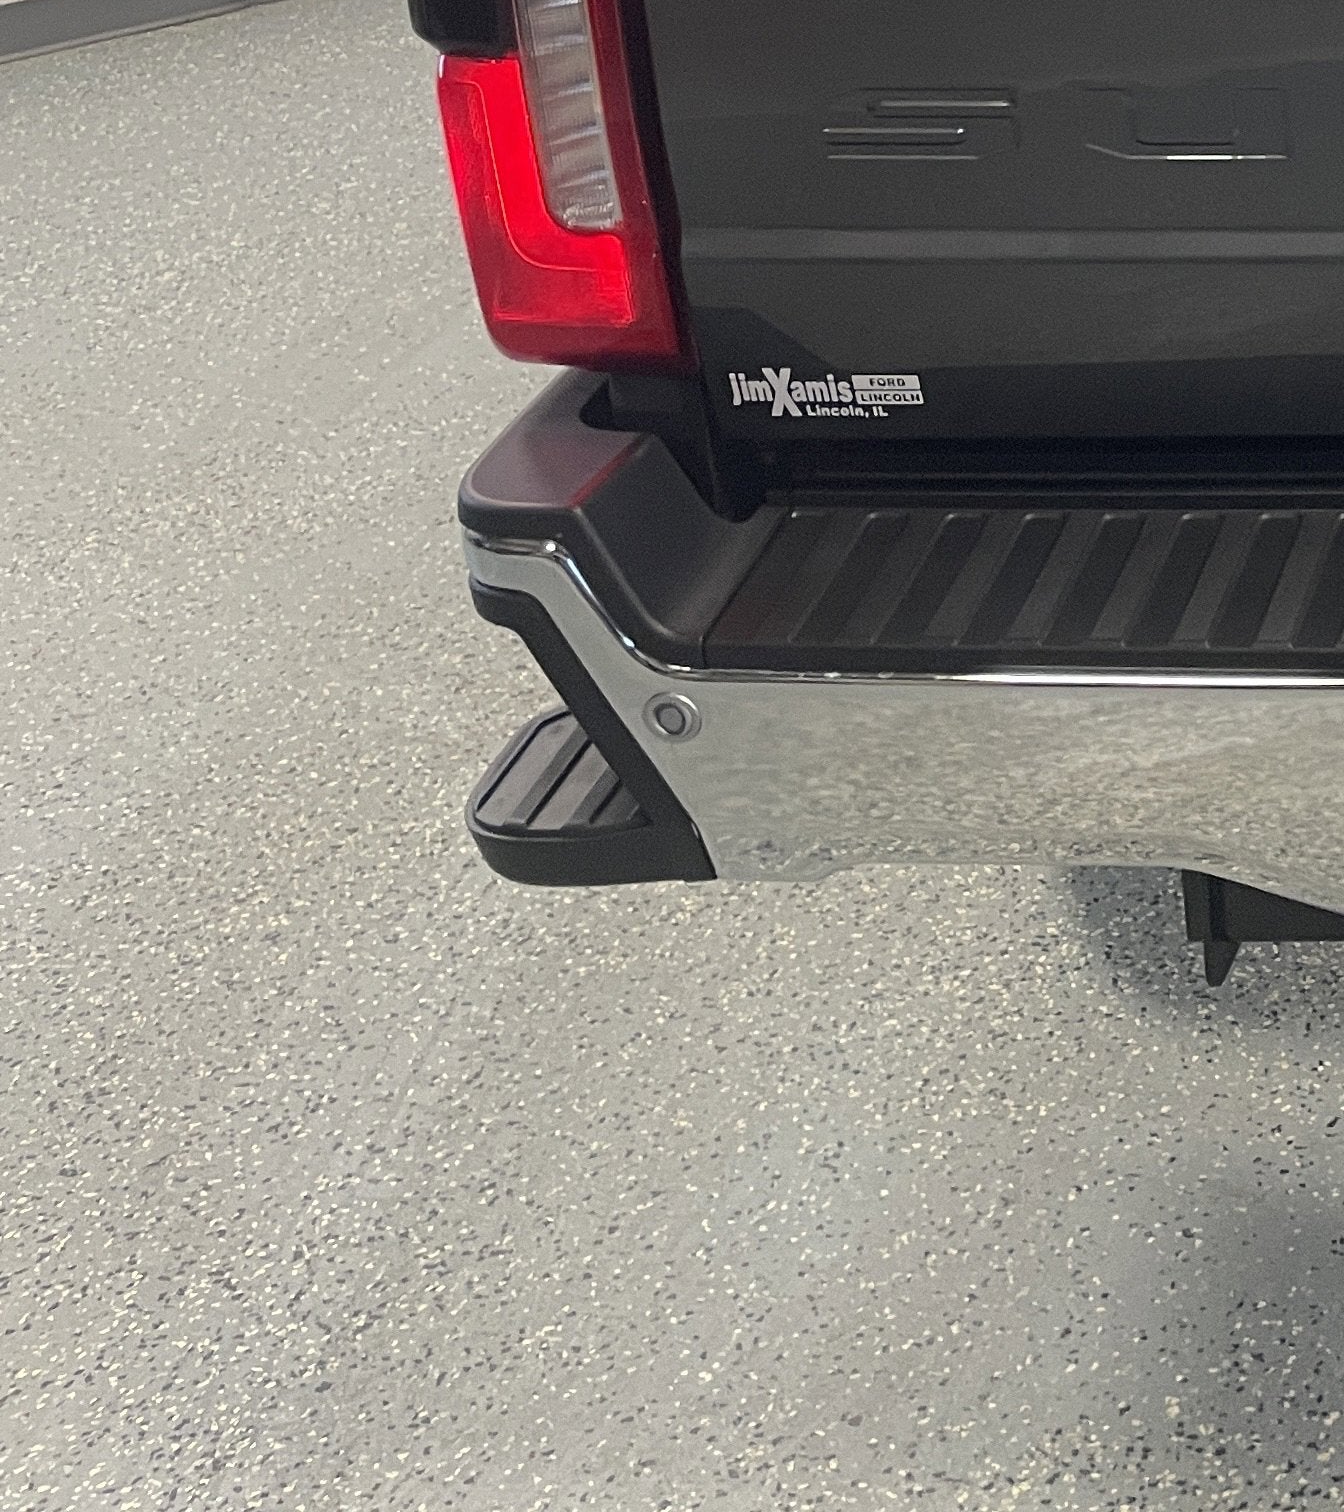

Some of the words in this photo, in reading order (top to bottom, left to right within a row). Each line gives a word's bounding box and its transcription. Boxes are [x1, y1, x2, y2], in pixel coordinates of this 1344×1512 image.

[869, 377, 907, 388] FORD
[860, 392, 922, 403] LINCOLN
[806, 404, 870, 419] Lincoln,
[872, 405, 889, 418] IL
